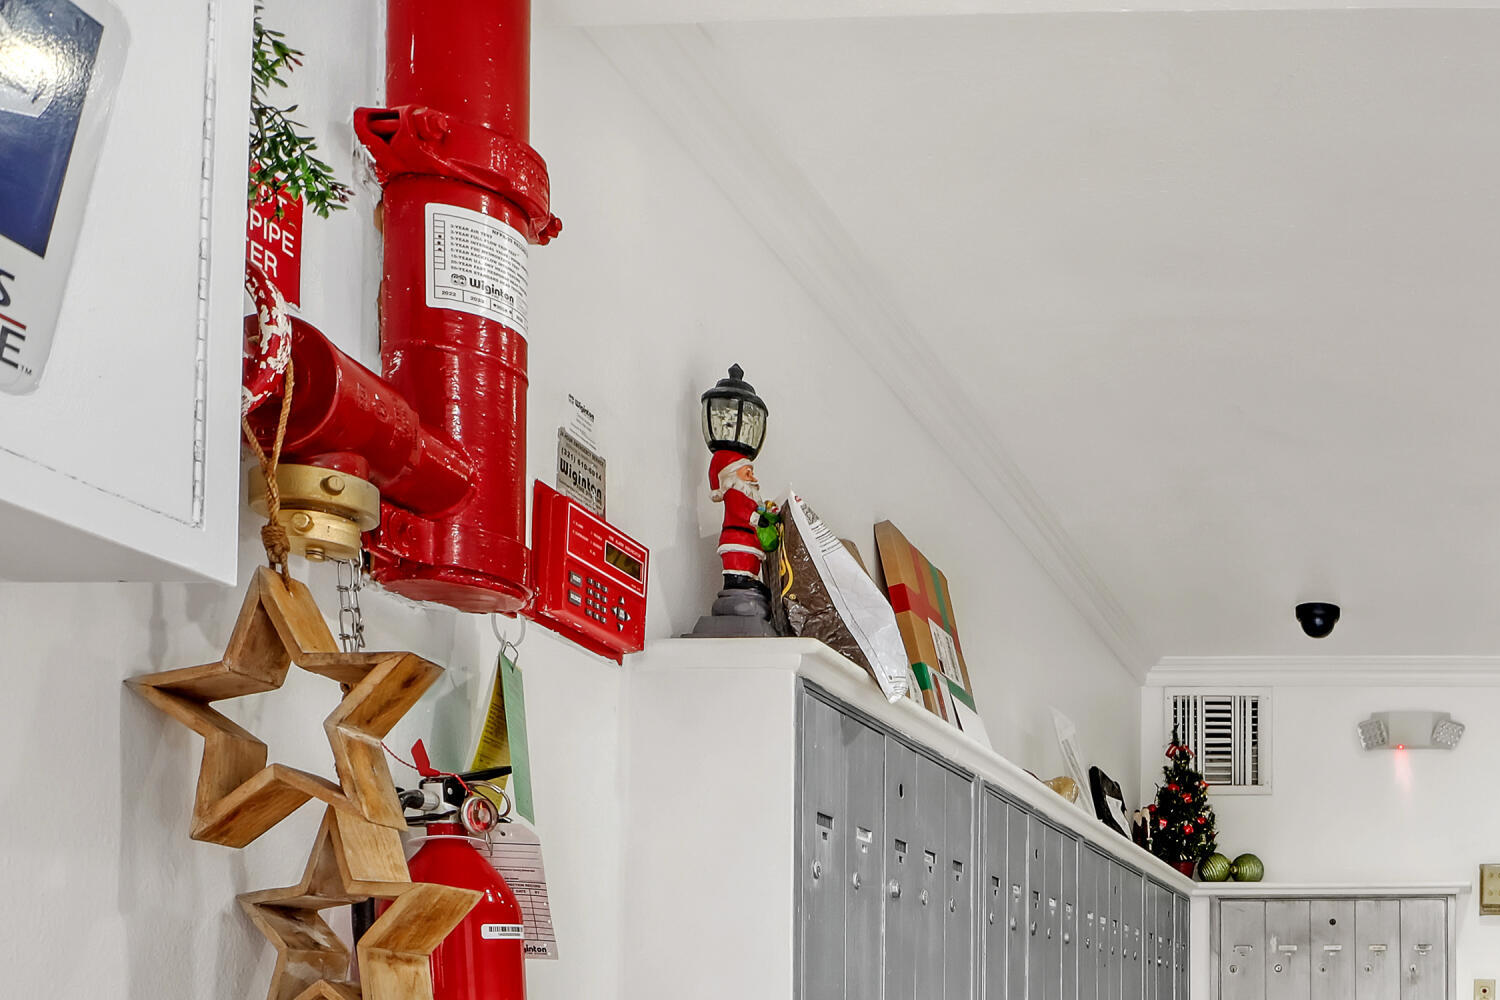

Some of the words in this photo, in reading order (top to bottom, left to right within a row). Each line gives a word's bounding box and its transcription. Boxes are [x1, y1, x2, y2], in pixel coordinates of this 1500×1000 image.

[250, 208, 294, 258] PIPE
[246, 238, 278, 278] ER
[469, 277, 514, 303] Wiginton
[560, 457, 602, 500] Wiginton
[524, 944, 547, 953] ginton
